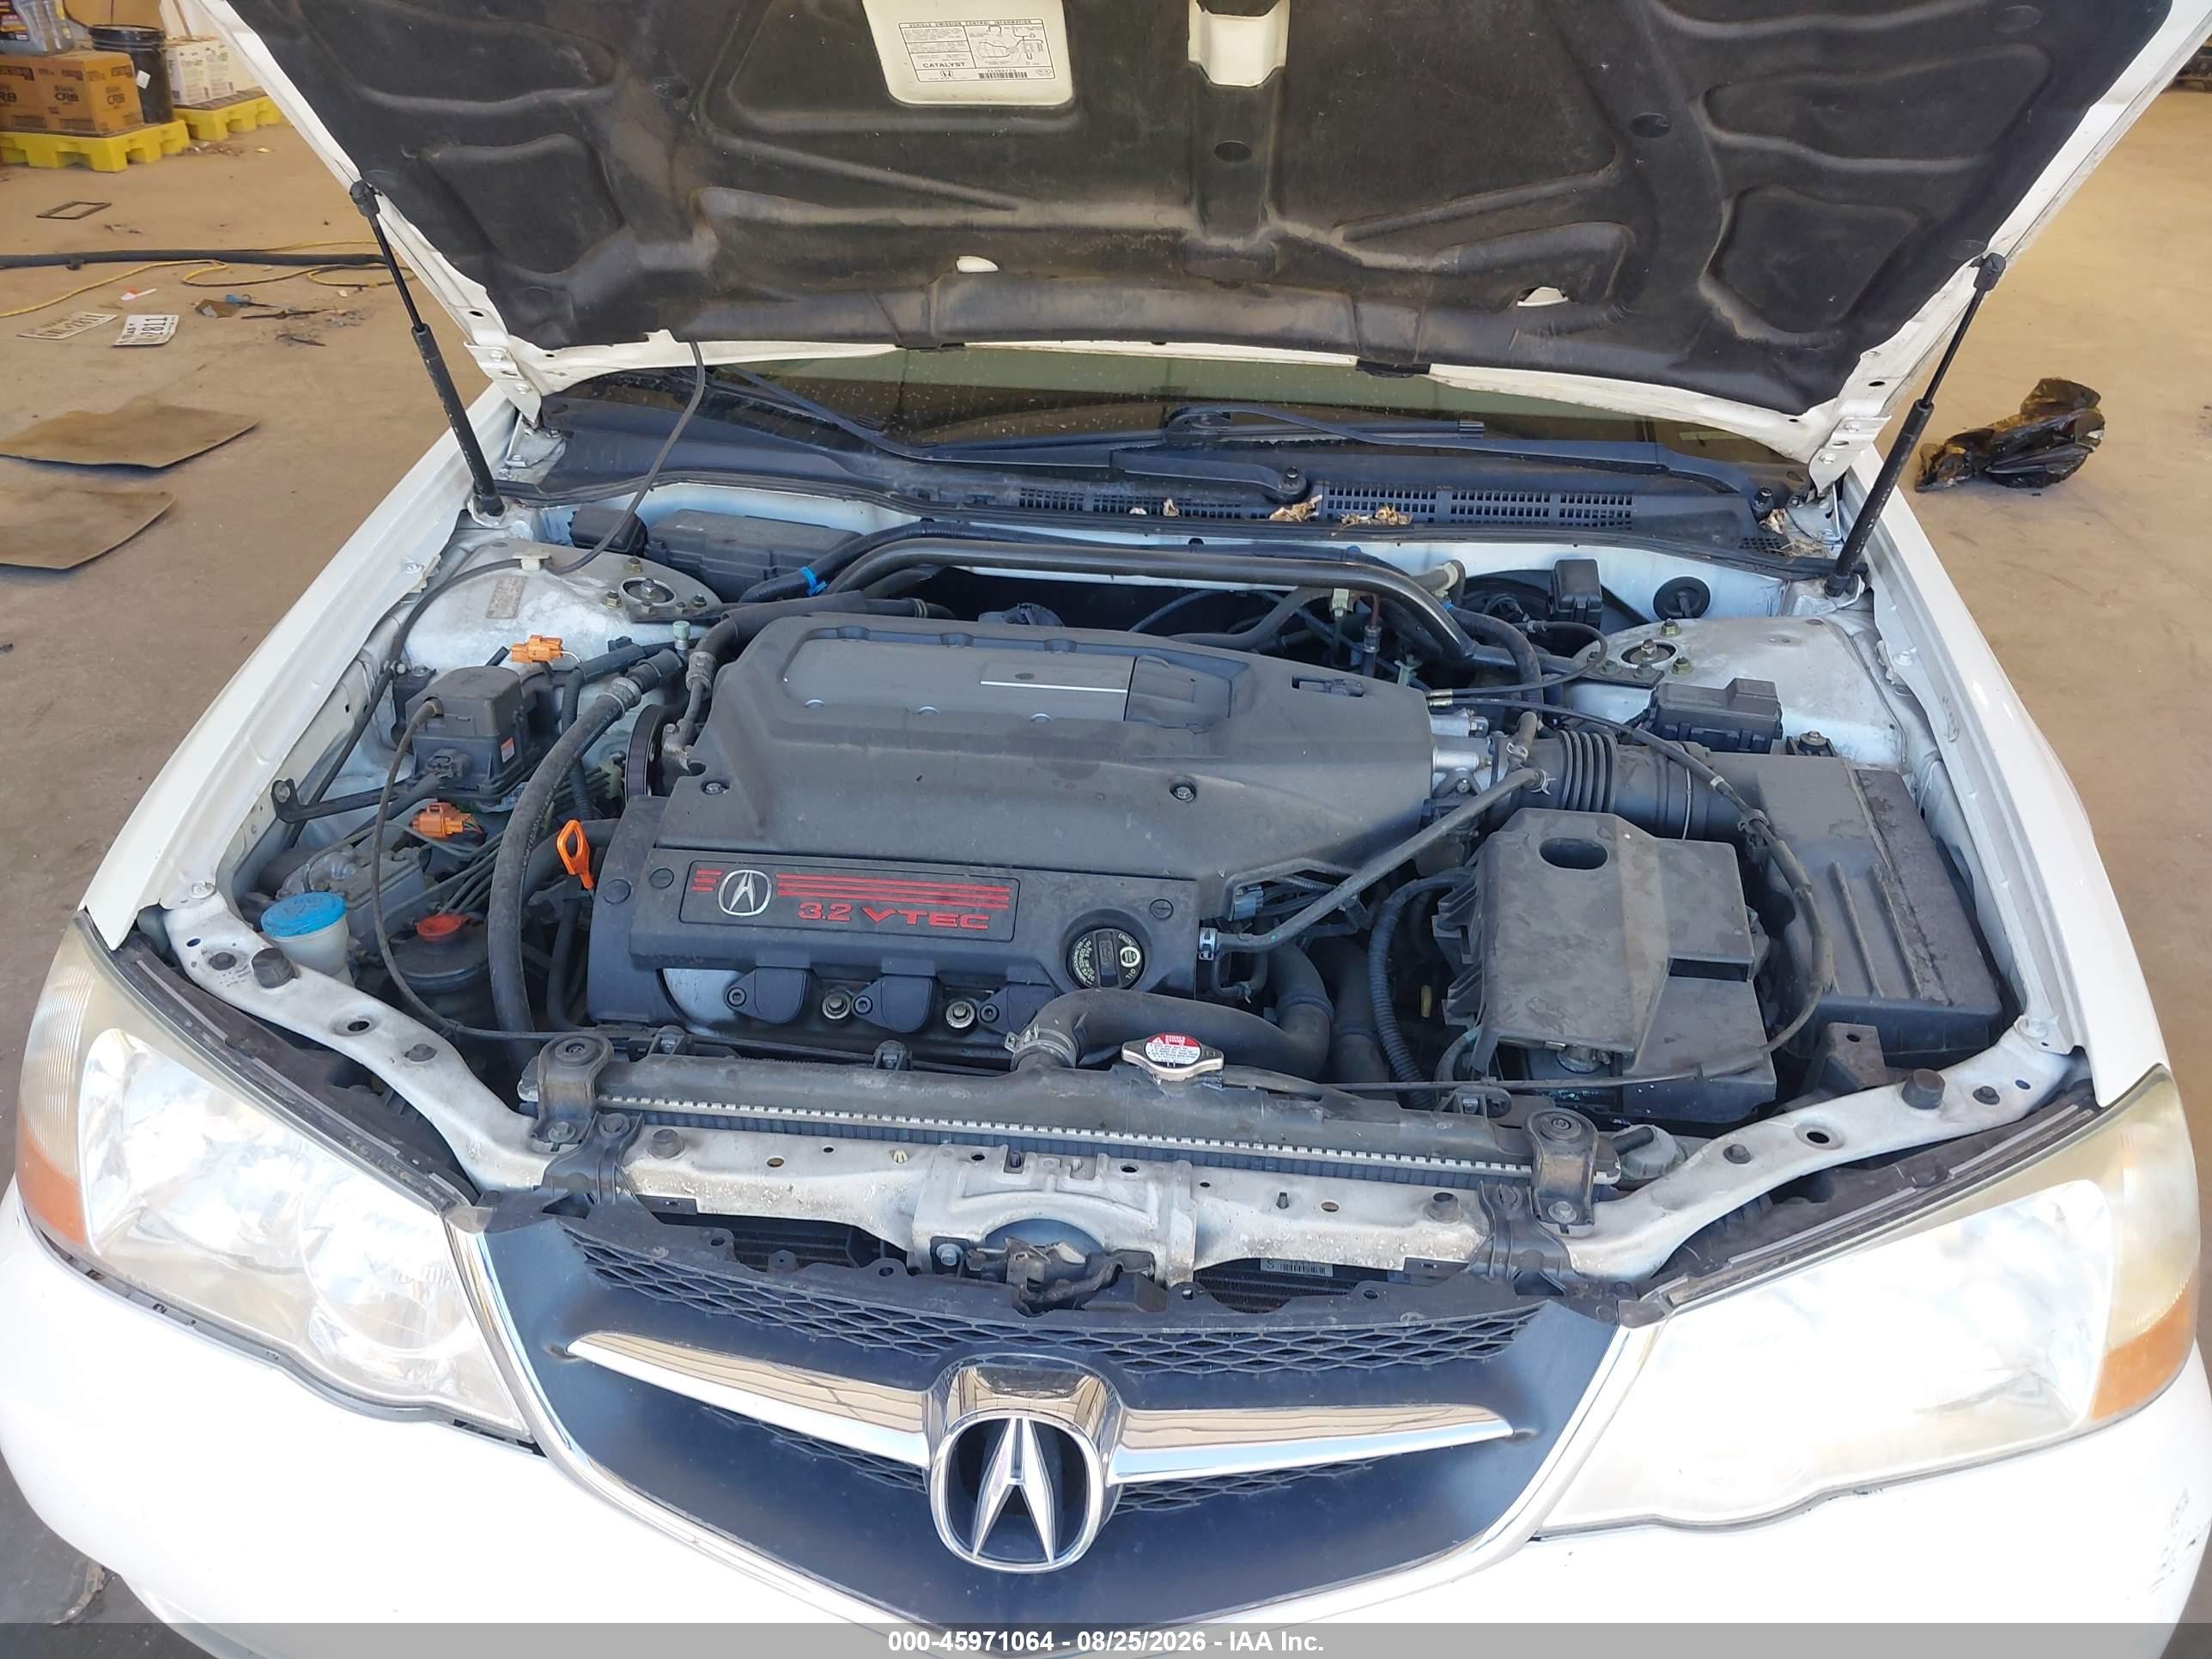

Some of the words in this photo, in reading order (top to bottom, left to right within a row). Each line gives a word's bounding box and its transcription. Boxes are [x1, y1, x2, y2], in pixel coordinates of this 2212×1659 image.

[54, 92, 79, 102] CRB
[106, 93, 125, 105] CRB
[798, 901, 853, 922] 3.2
[860, 906, 991, 930] VTEC
[1125, 968, 1136, 980] OIL
